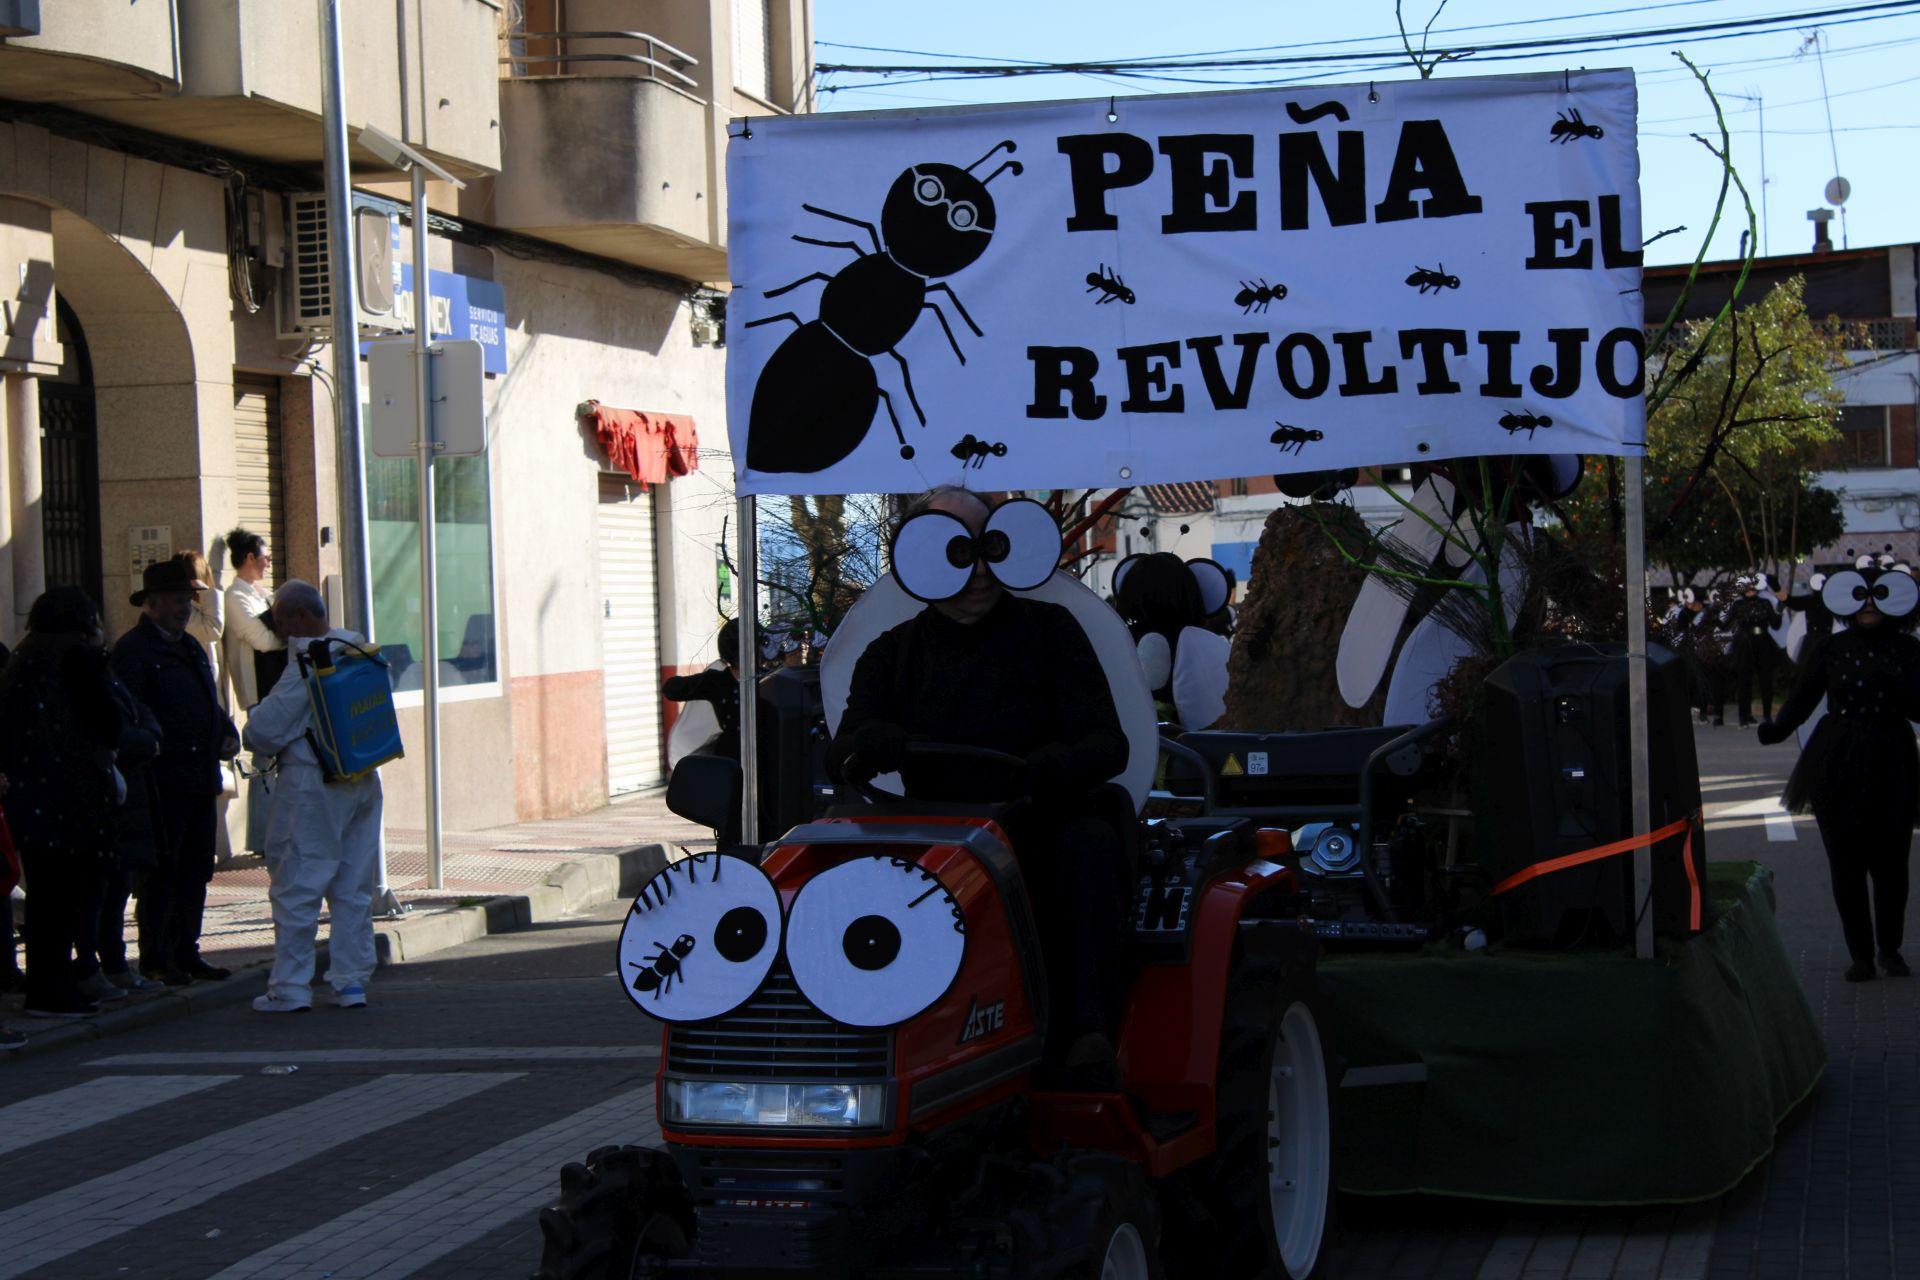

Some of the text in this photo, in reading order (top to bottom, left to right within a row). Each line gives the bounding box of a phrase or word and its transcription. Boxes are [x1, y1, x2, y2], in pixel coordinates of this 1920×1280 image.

[1056, 101, 1644, 270] PEÑA EL
[469, 305, 498, 324] SERVICIO
[1026, 327, 1646, 420] REVOLTIJO
[961, 1000, 1005, 1041] ASTE
